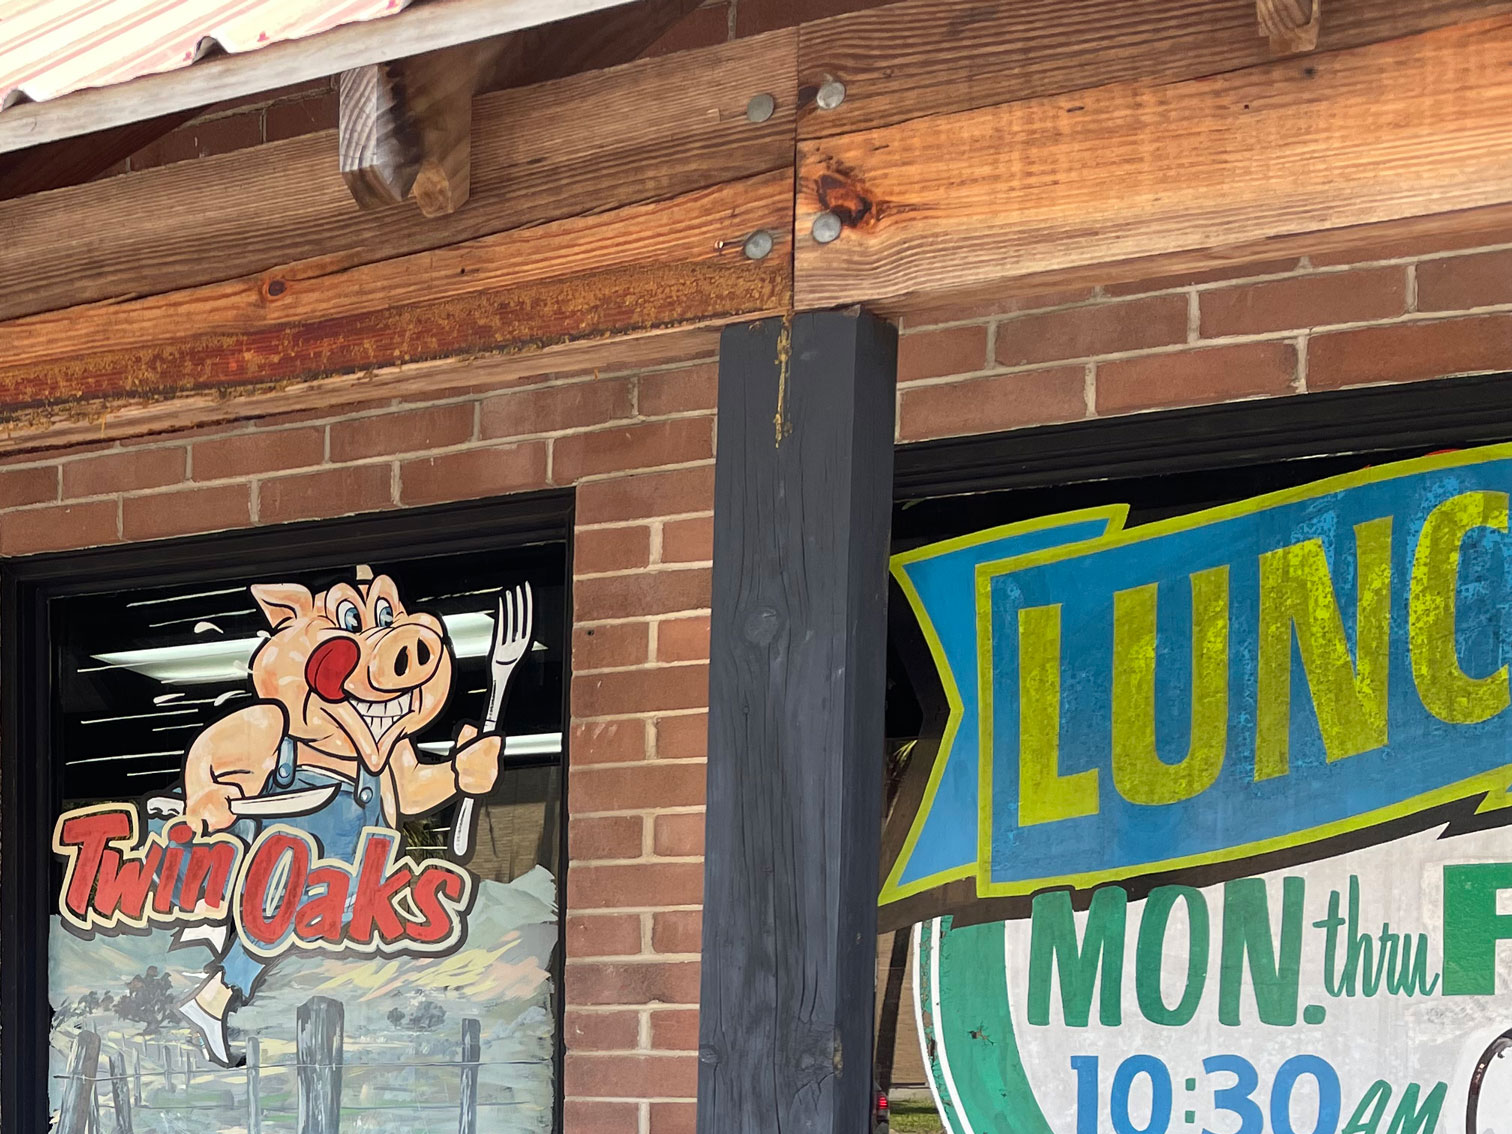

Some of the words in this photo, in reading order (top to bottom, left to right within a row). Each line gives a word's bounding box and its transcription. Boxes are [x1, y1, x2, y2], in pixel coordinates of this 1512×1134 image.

[58, 804, 237, 922] Twin
[241, 828, 468, 949] Oaks
[1312, 874, 1441, 998] thru
